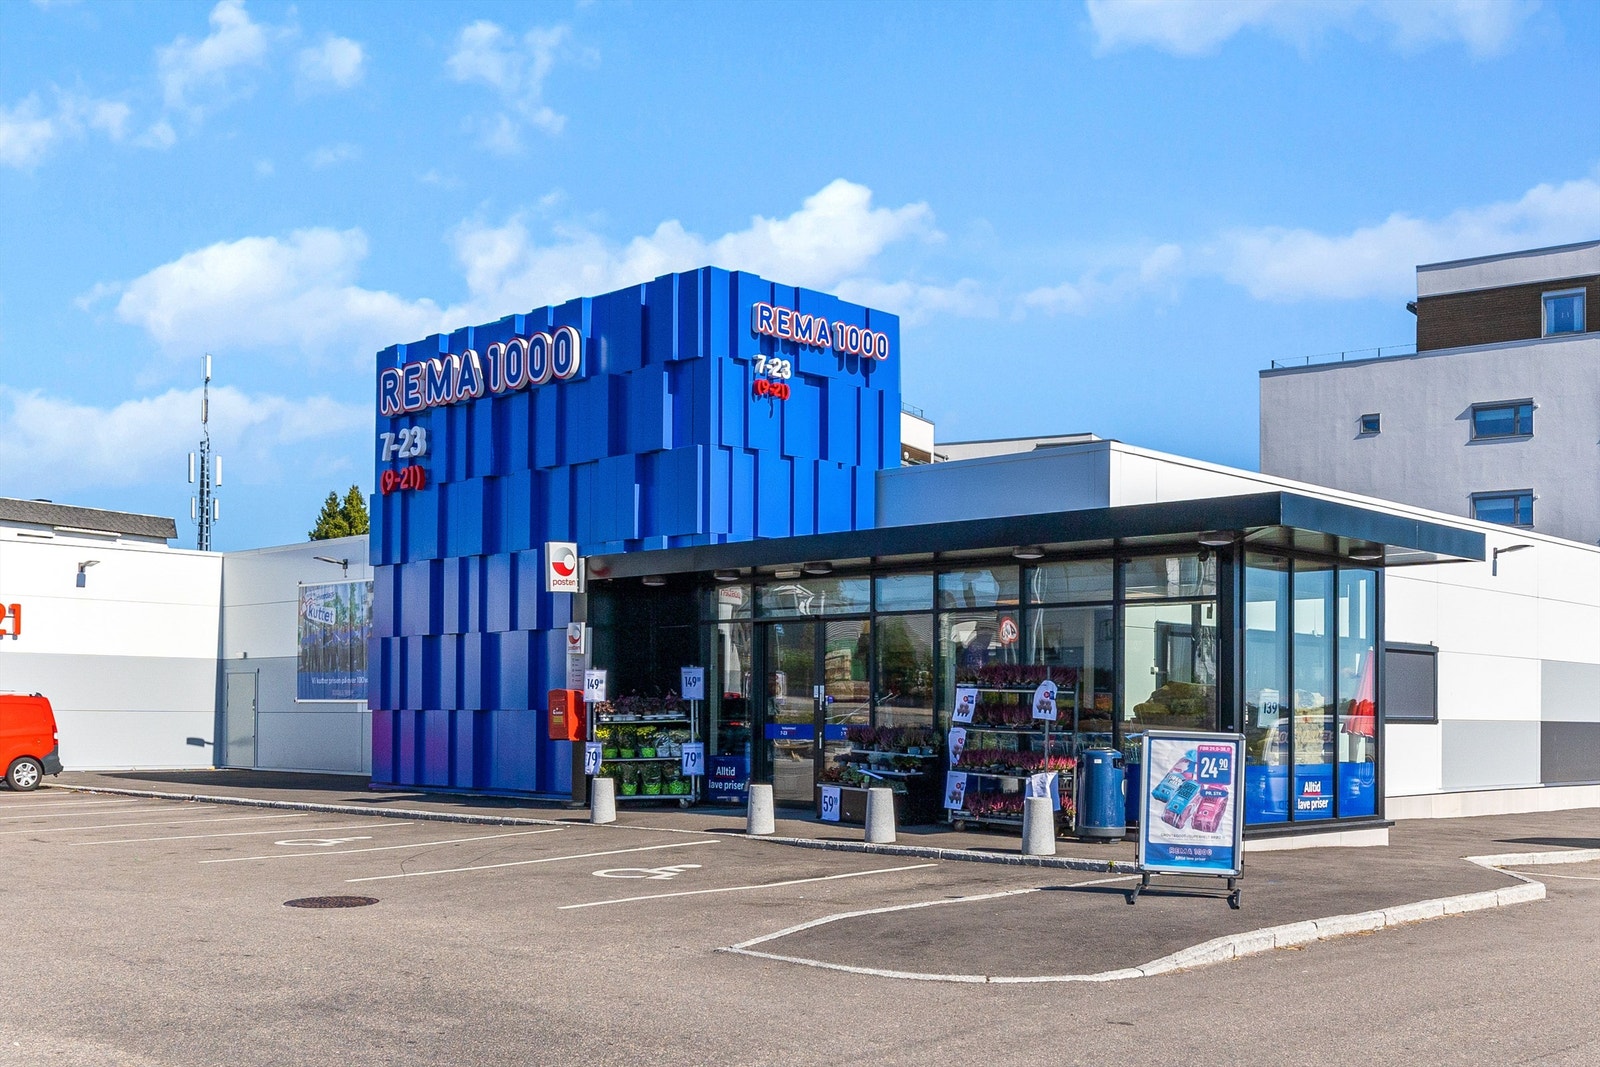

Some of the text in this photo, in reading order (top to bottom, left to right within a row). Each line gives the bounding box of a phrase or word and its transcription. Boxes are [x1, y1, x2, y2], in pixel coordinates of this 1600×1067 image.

[755, 302, 889, 360] REMA 1000
[380, 325, 581, 416] REMA 1000
[753, 354, 791, 379] 7-23
[754, 379, 790, 401] (9-21)
[380, 425, 427, 461] 7-23
[380, 465, 425, 495] (9-21)
[552, 578, 577, 587] posten
[587, 678, 599, 690] 149
[684, 676, 697, 688] 149
[1263, 702, 1278, 715] 139
[586, 751, 598, 766] 79
[684, 752, 697, 768] 79
[715, 766, 736, 776] Alltid
[708, 780, 744, 791] lave priser
[1303, 780, 1321, 793] Alltid
[823, 795, 834, 812] 59
[1297, 797, 1329, 811] lave priser
